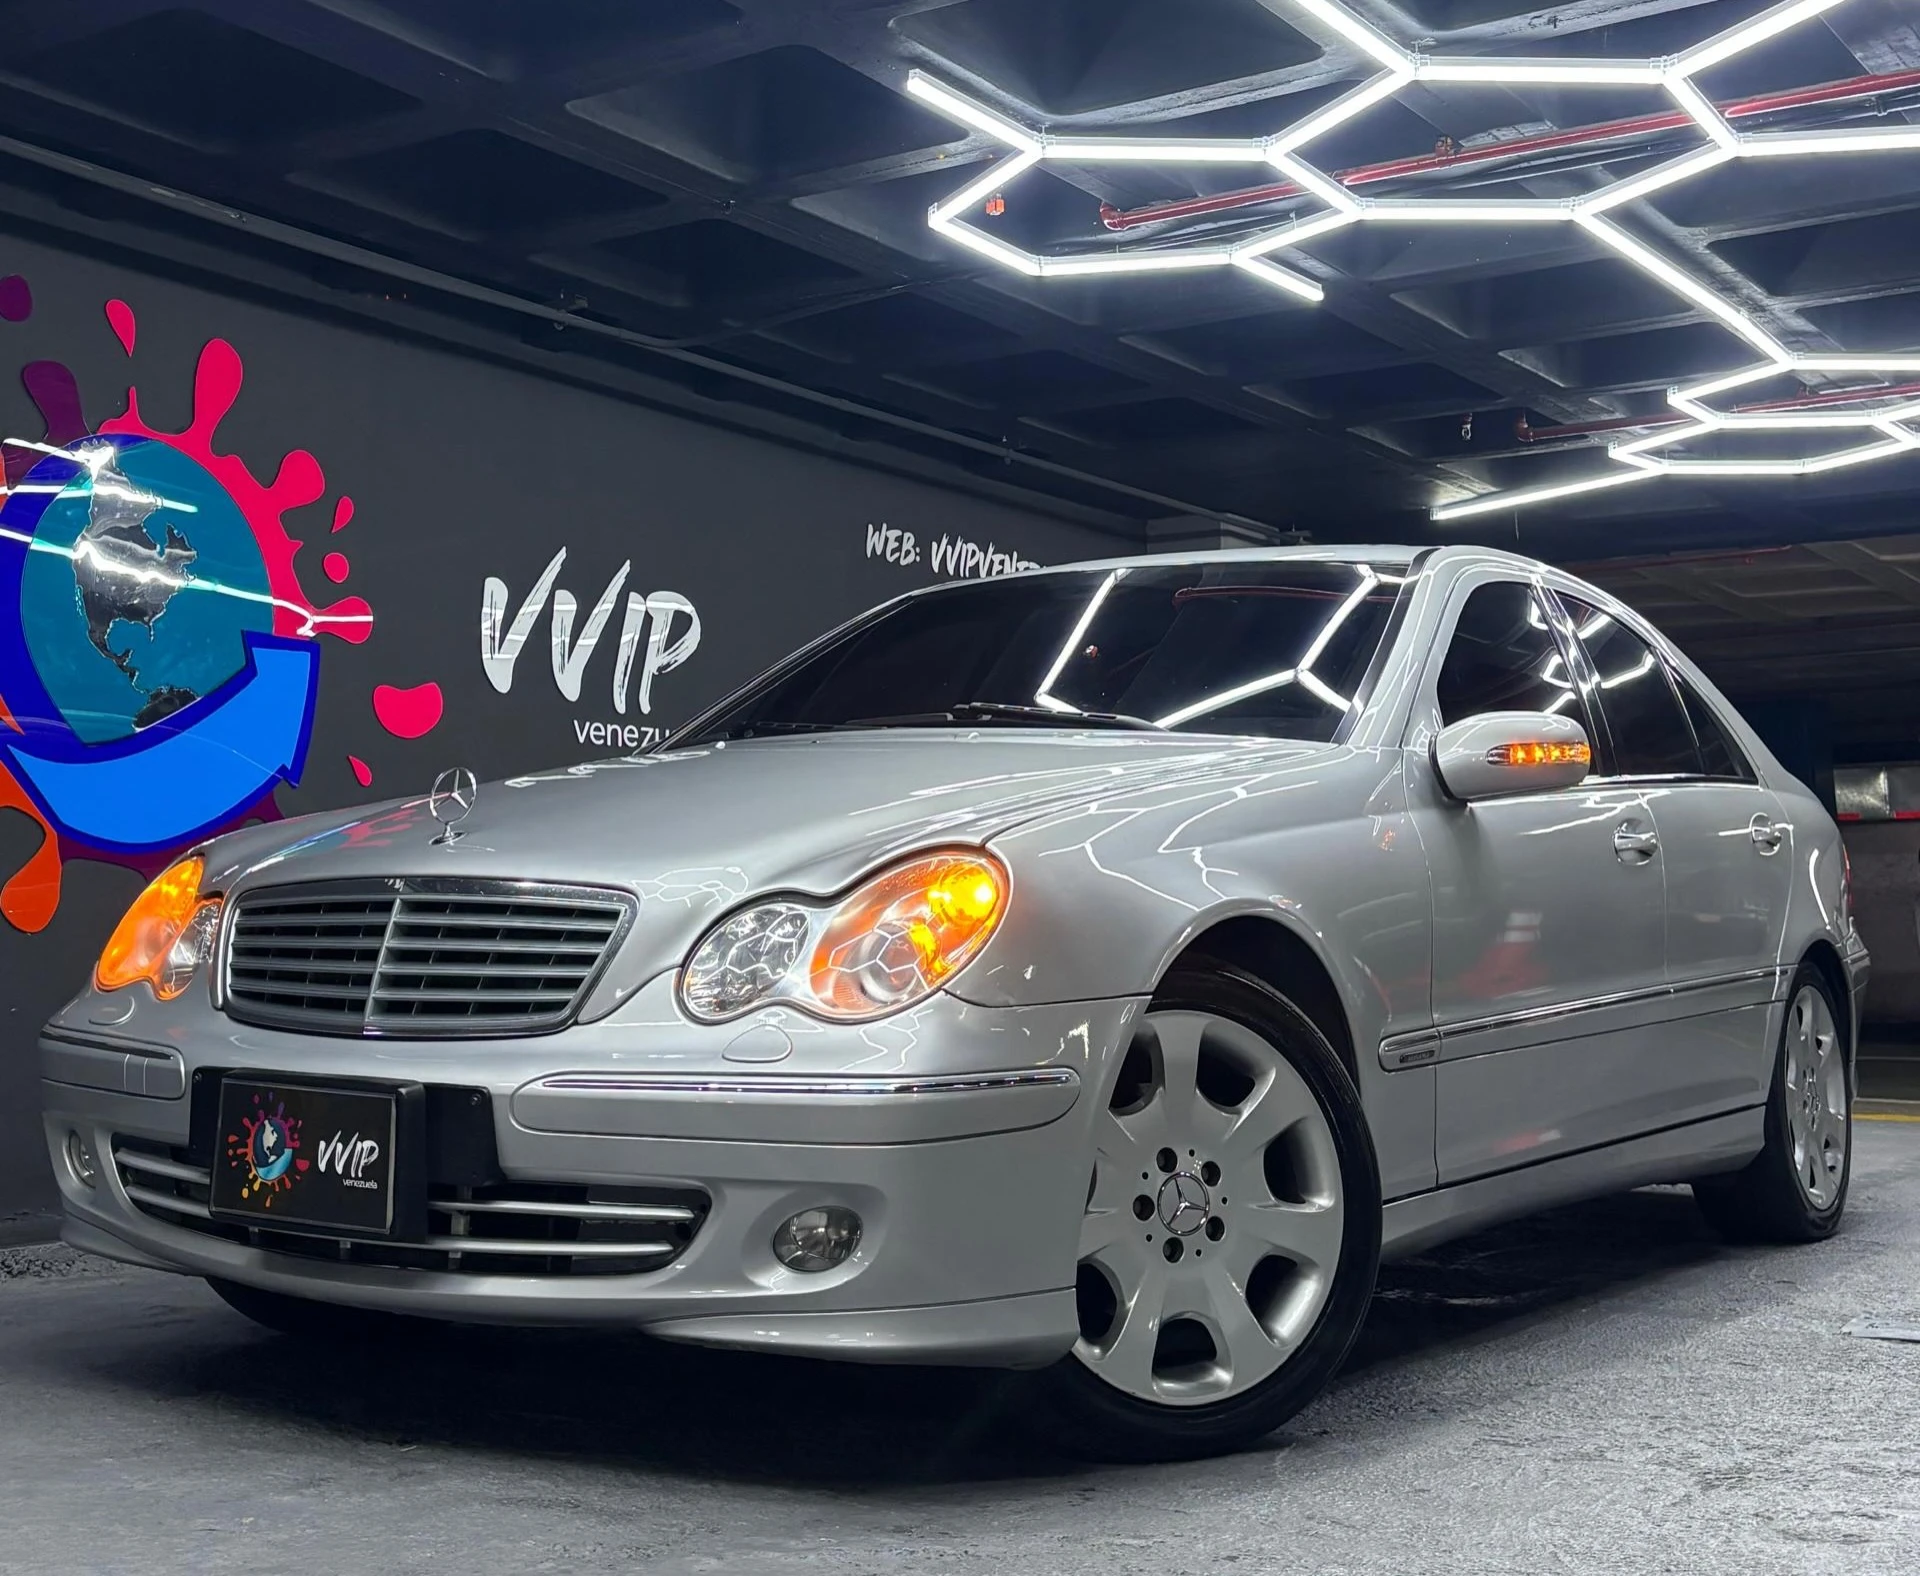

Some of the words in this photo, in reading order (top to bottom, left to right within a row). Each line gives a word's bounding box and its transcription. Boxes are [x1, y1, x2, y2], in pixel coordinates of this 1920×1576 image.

[866, 522, 921, 566] WEB:
[481, 546, 701, 715] VVIP
[317, 1130, 380, 1178] VVIP
[342, 1178, 378, 1189] venezuela
